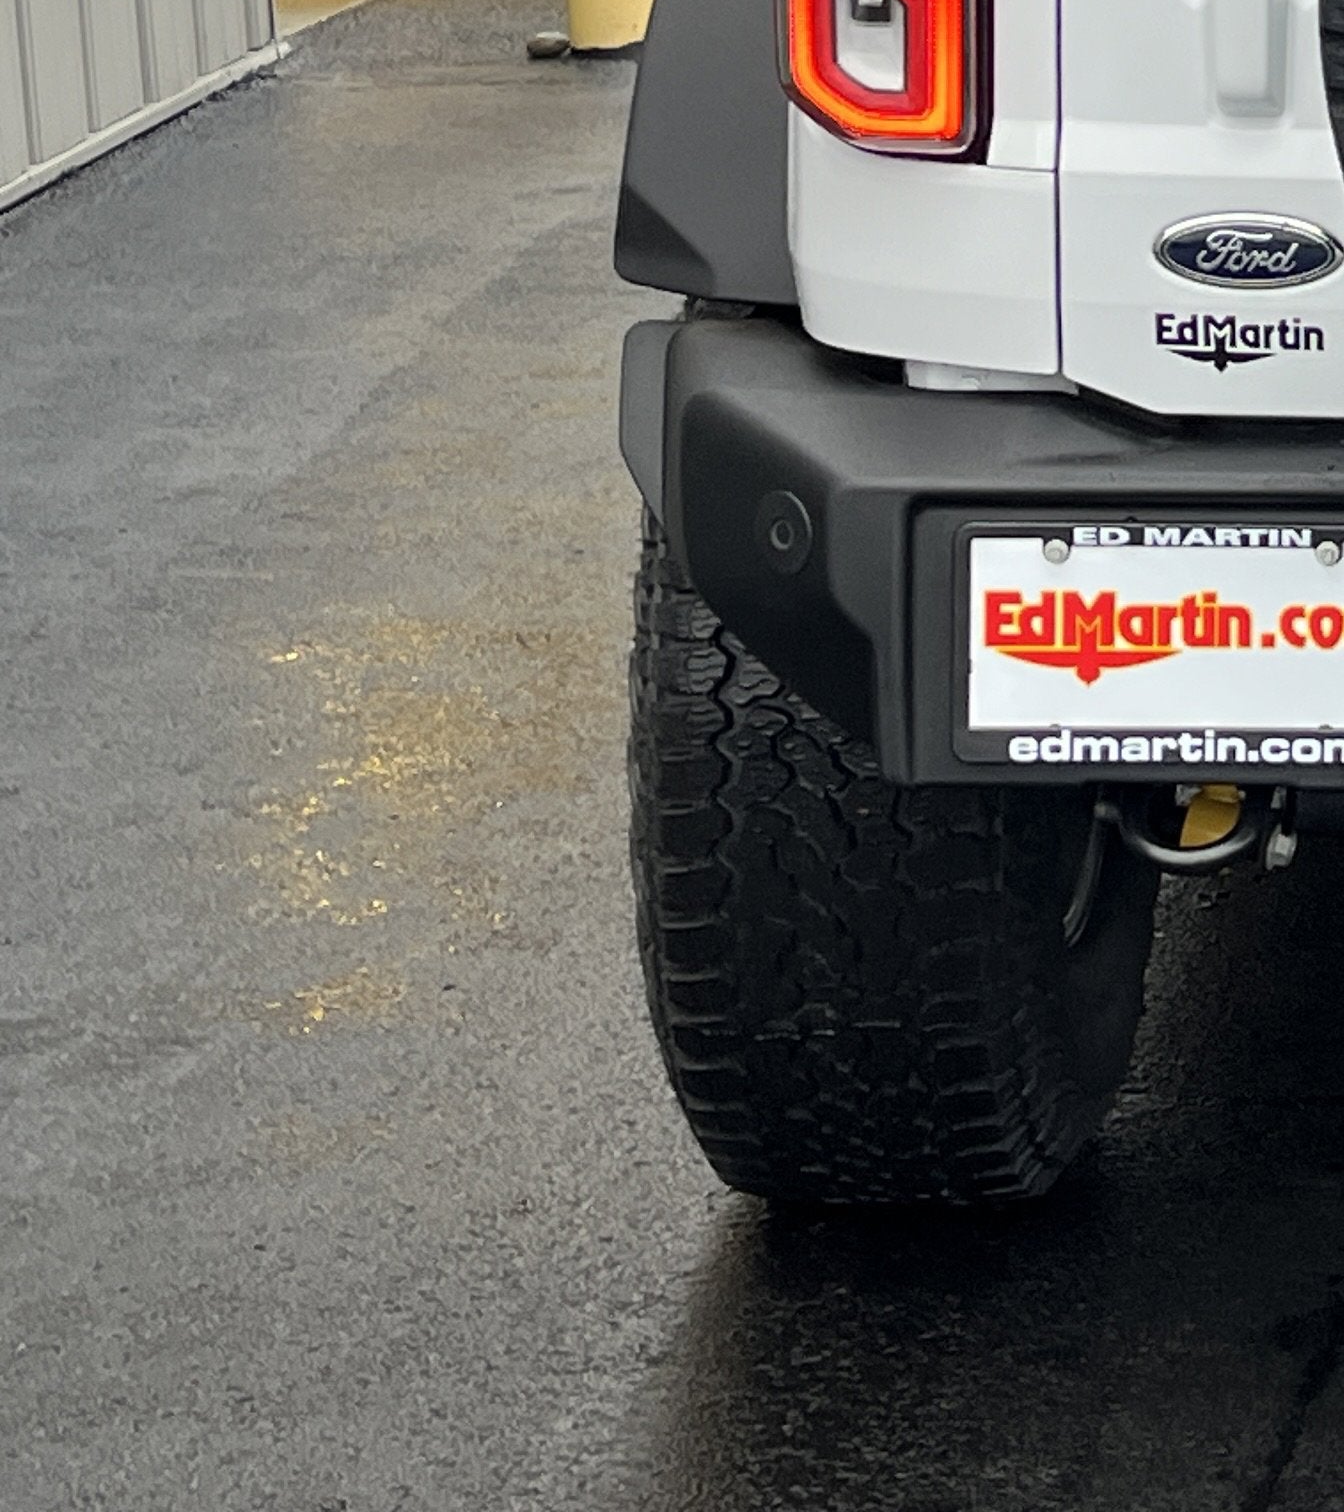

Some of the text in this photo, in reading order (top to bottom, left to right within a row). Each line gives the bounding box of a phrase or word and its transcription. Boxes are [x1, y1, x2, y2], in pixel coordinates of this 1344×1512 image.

[1196, 229, 1299, 272] Ford
[1073, 527, 1312, 547] ED MARTIN
